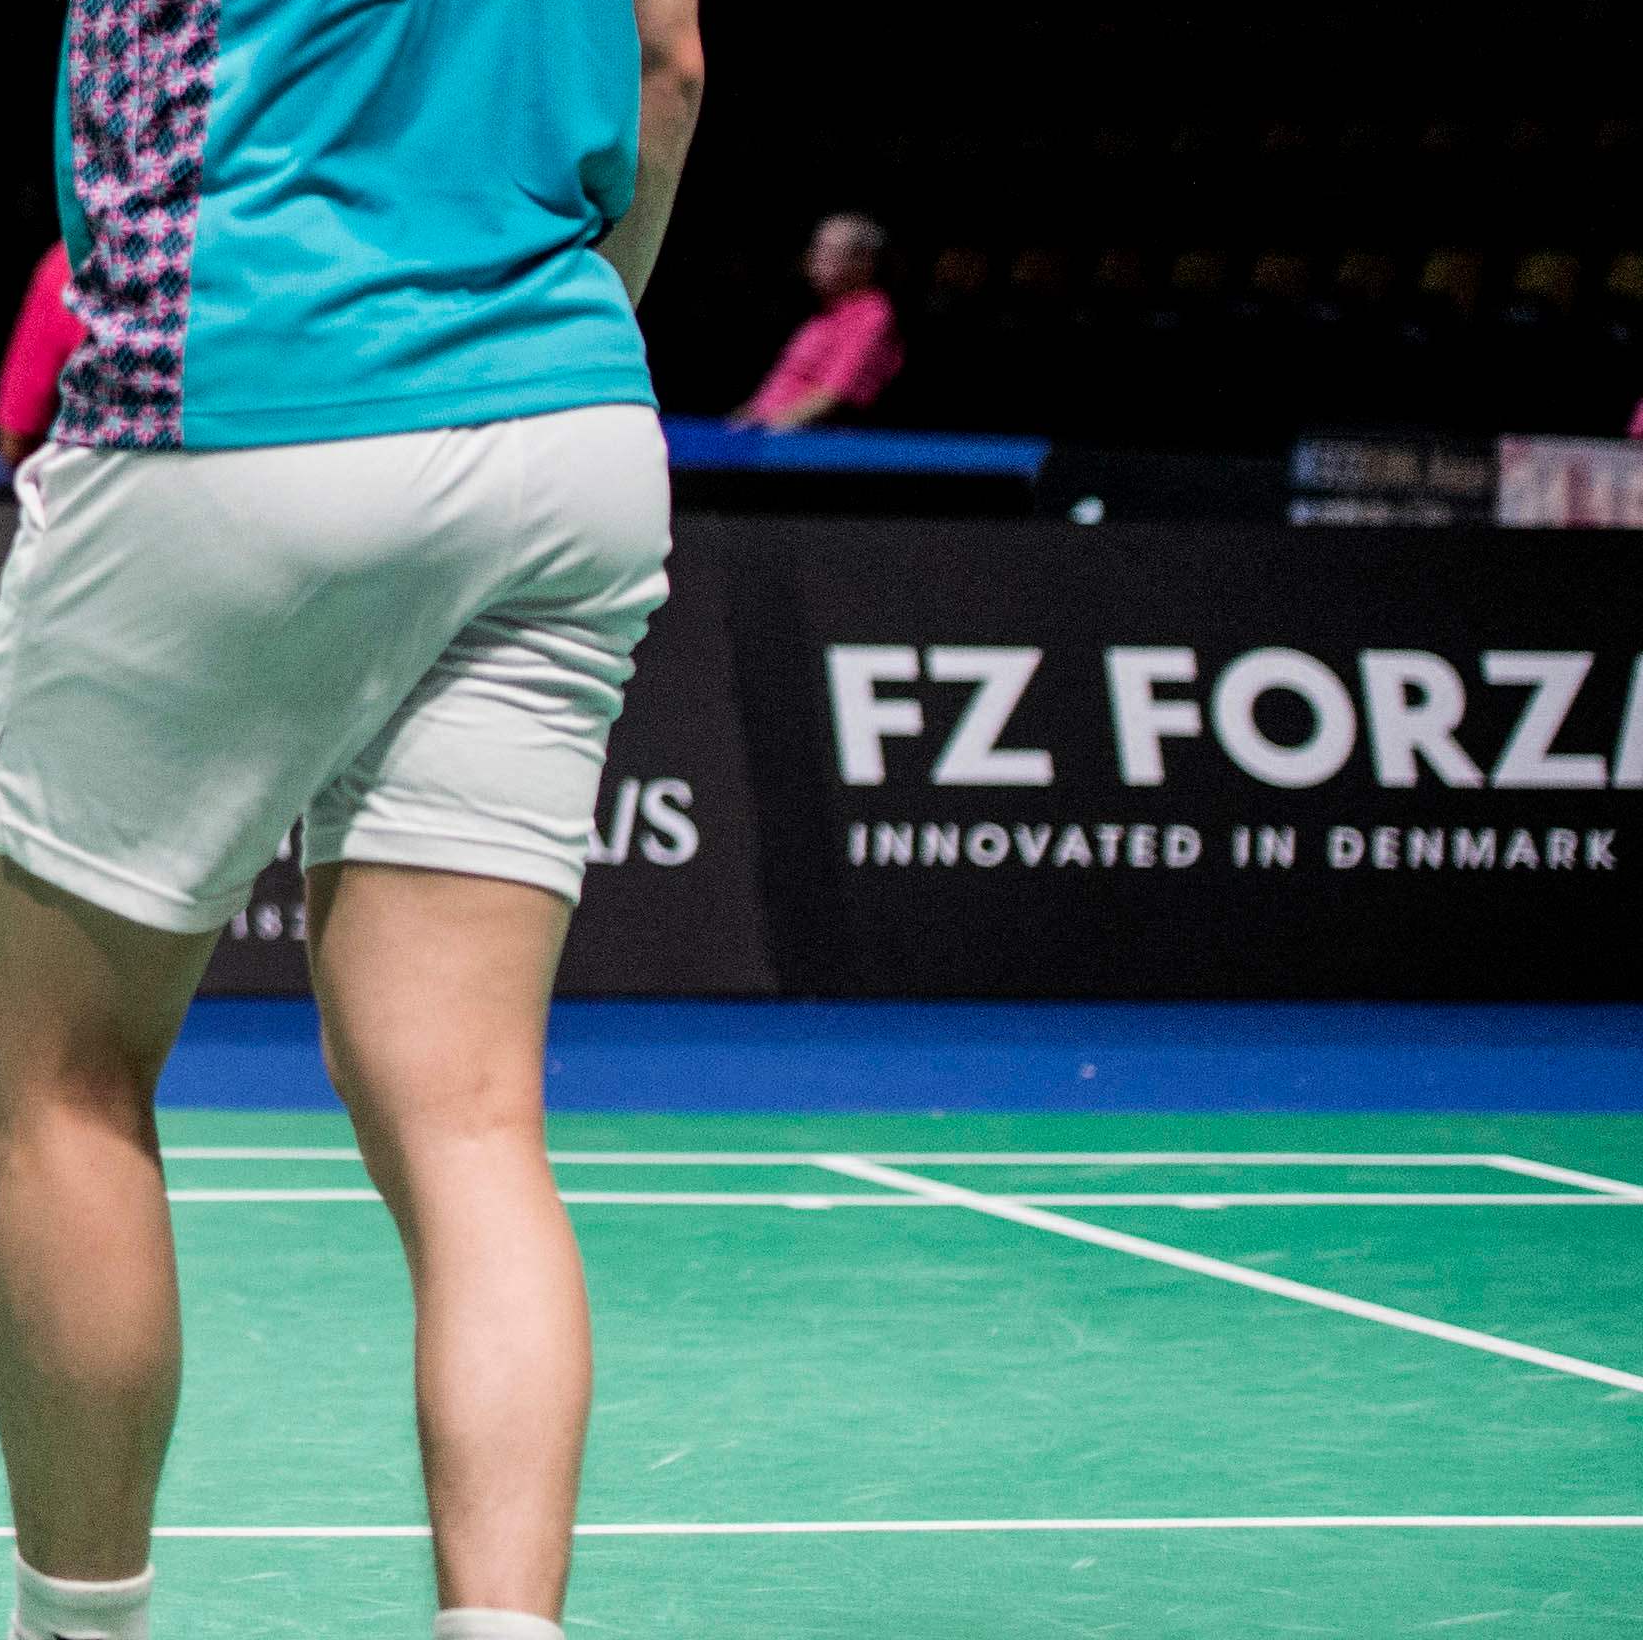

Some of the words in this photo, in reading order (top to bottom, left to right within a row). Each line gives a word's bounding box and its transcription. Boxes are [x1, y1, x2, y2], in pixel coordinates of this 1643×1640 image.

[825, 643, 1054, 787] FZ
[1102, 644, 1643, 791] FORZ
[847, 822, 1204, 869] INNOVATED
[1230, 824, 1297, 871] IN
[1326, 824, 1616, 871] DENMARK
